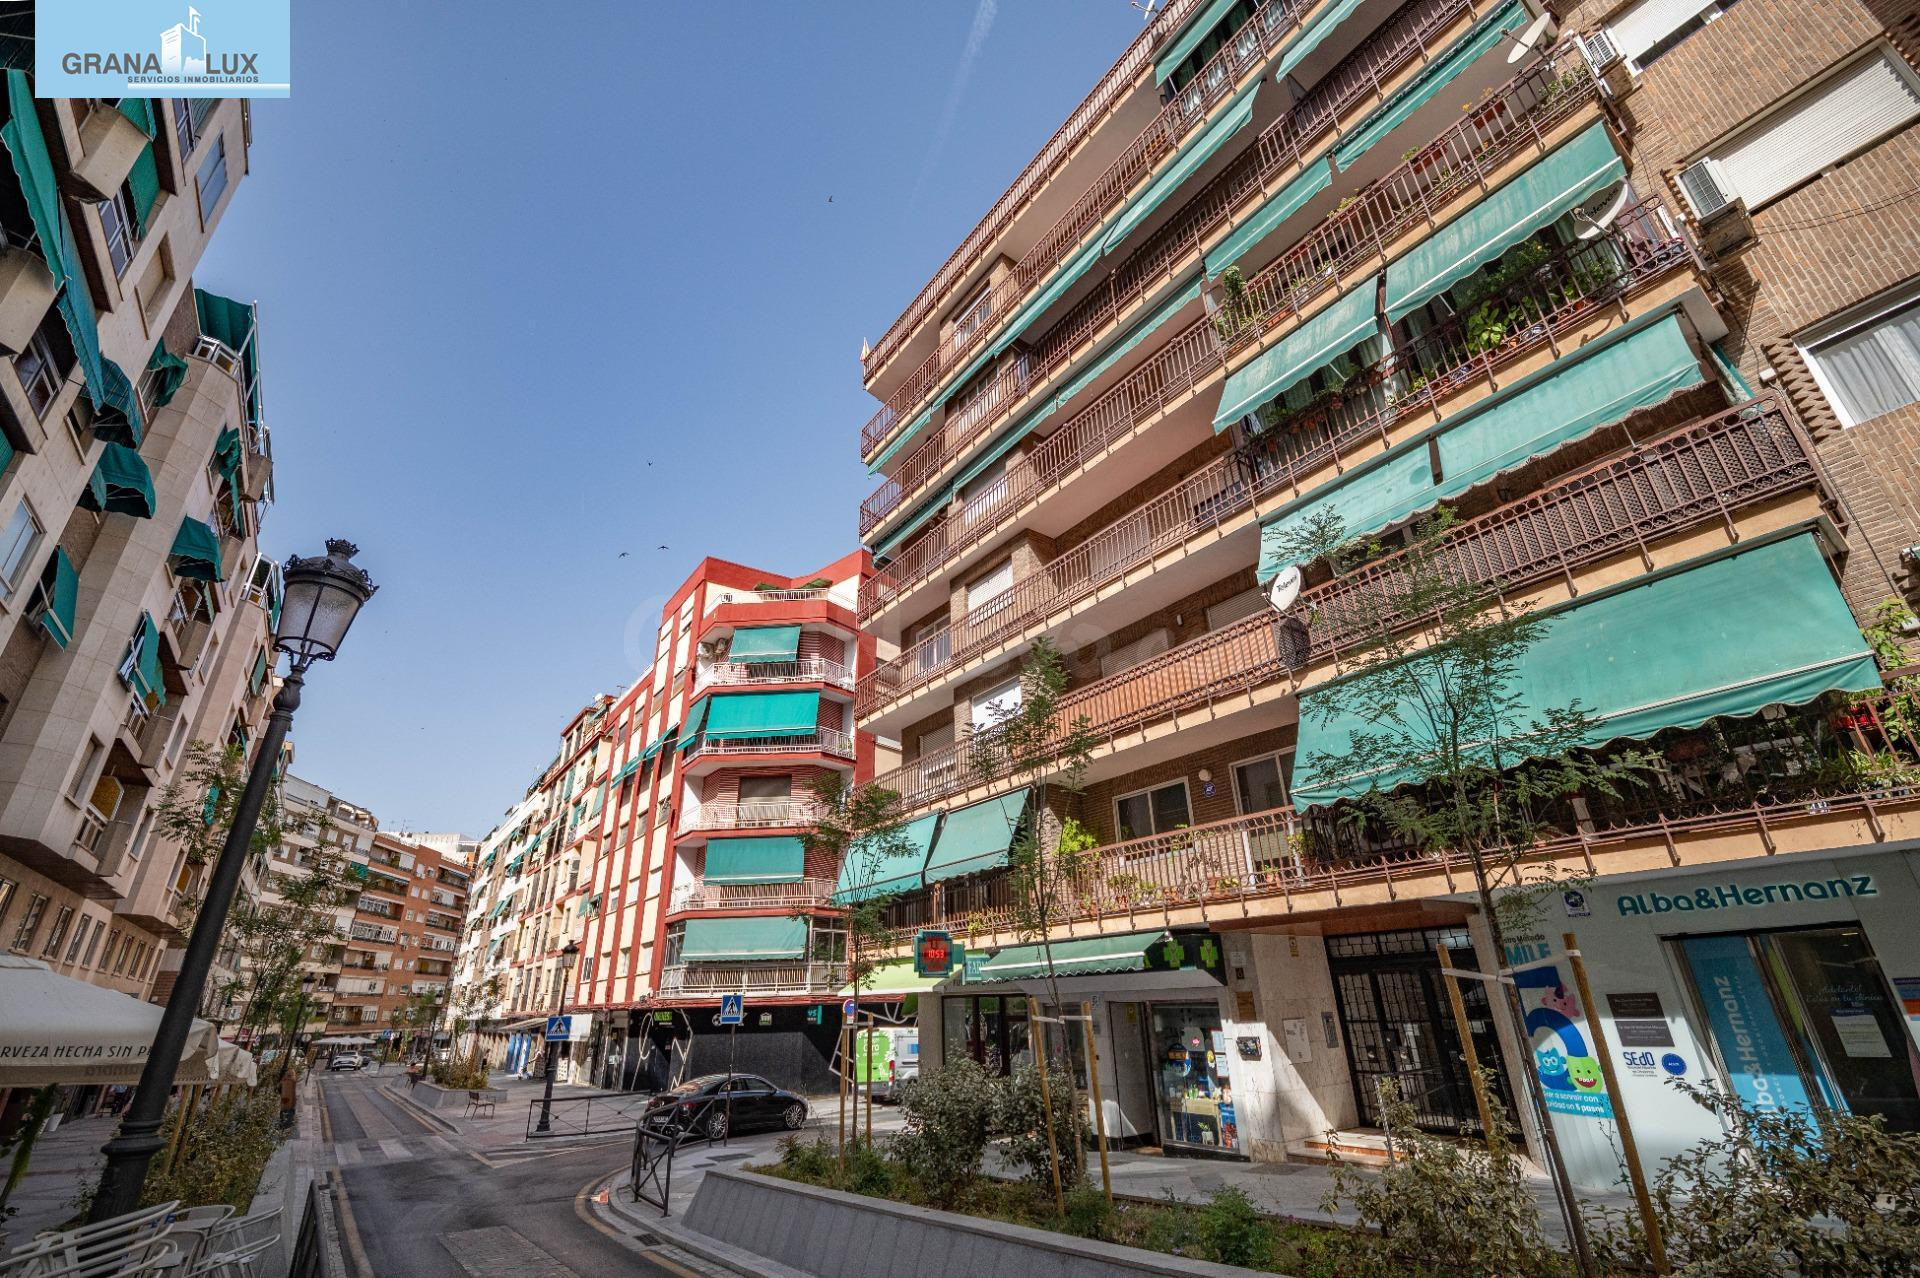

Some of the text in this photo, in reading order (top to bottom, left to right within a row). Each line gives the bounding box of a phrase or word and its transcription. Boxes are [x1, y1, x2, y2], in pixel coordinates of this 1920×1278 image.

[1617, 875, 1877, 917] Alba&Hernanz
[0, 1045, 49, 1058] RVEZA
[53, 1045, 102, 1058] HECHA
[107, 1045, 132, 1058] SIN
[1713, 975, 1778, 1114] lba&Hernanz
